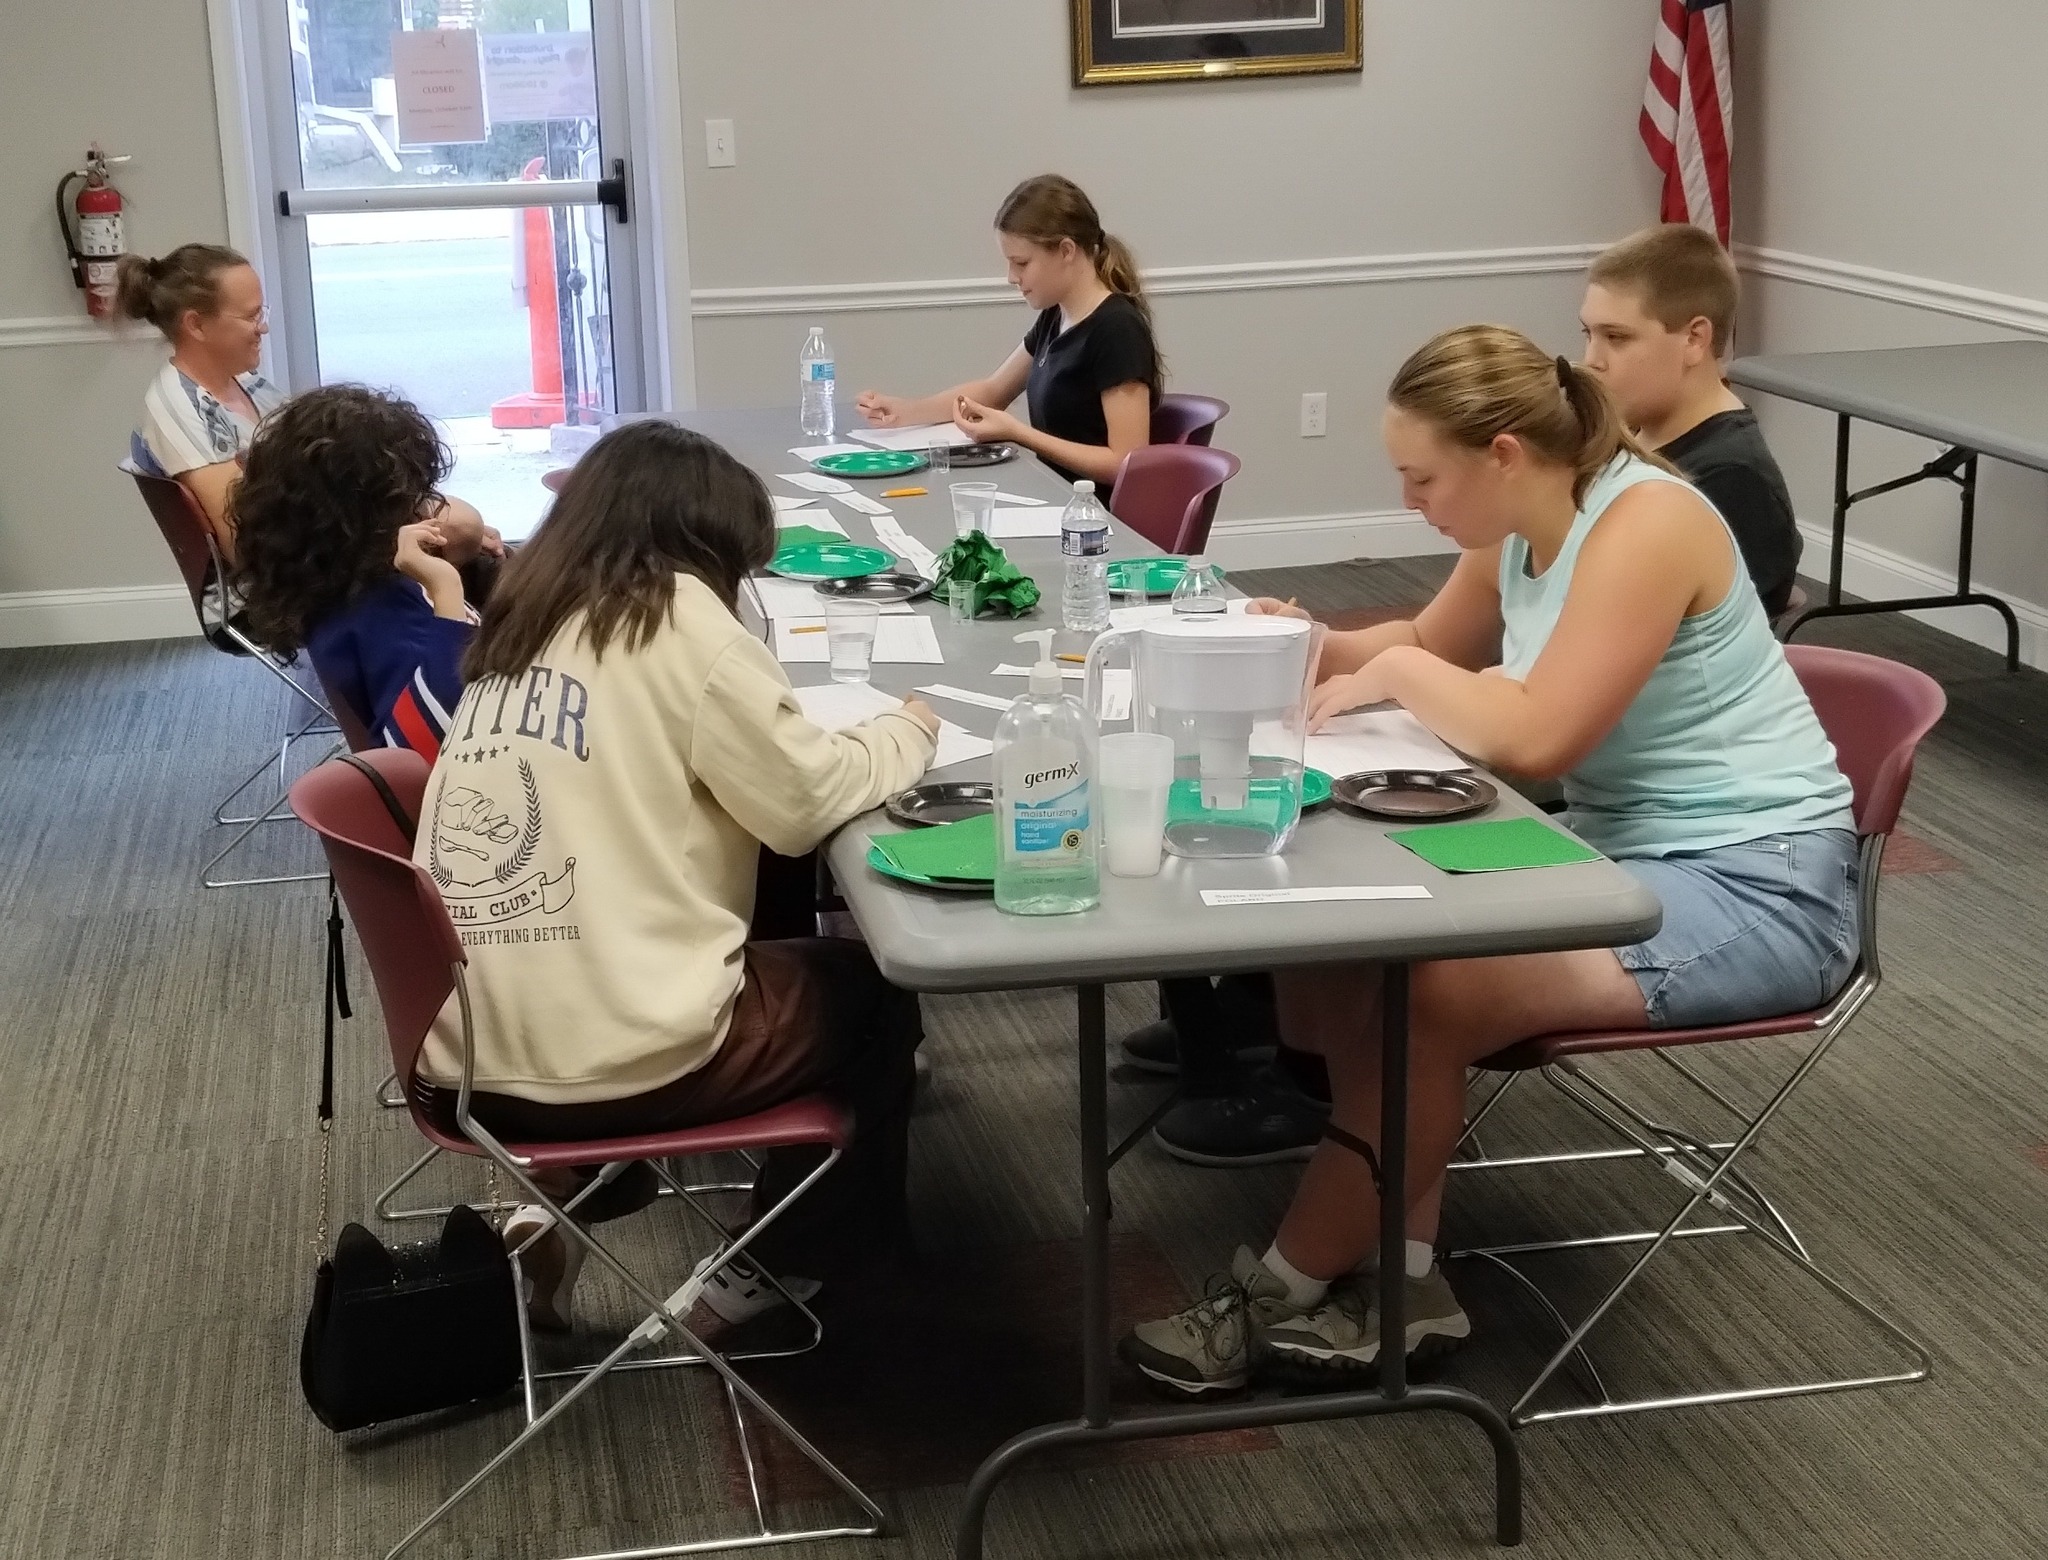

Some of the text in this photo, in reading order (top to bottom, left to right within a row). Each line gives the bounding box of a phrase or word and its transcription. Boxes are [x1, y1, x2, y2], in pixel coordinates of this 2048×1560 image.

[422, 85, 455, 94] CLOSED
[1020, 808, 1078, 818] moisturizing
[489, 892, 531, 917] CLUB
[461, 925, 581, 946] EVERYTHING BETTER
